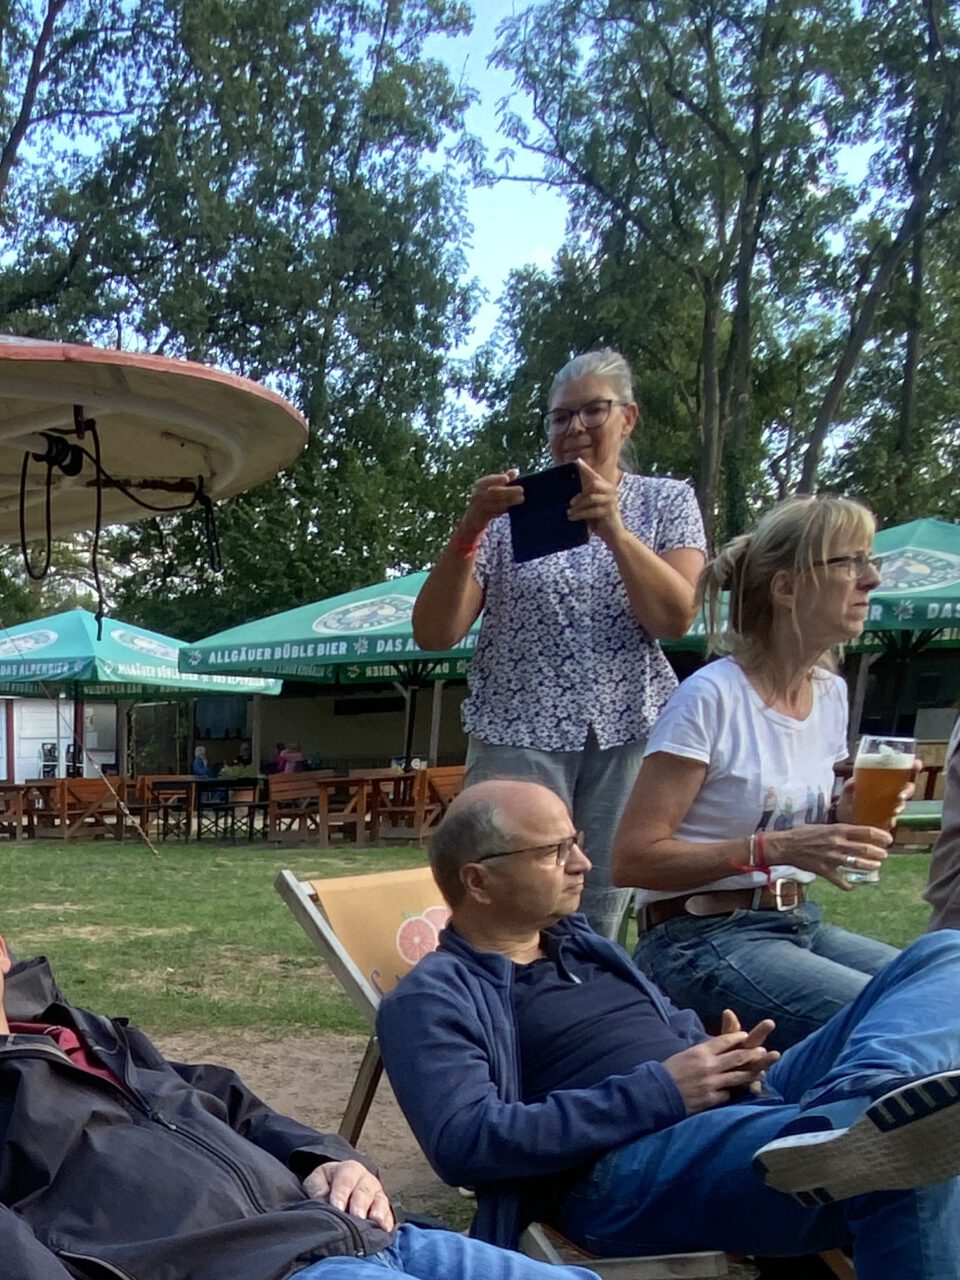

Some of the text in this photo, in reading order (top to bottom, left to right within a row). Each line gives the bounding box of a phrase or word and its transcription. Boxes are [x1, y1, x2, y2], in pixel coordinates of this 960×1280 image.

[208, 646, 271, 664] ALLGÄUER
[274, 643, 315, 660] BÜBLE
[317, 641, 348, 656] BIER
[376, 639, 403, 653] DAS
[0, 663, 17, 677] DAS
